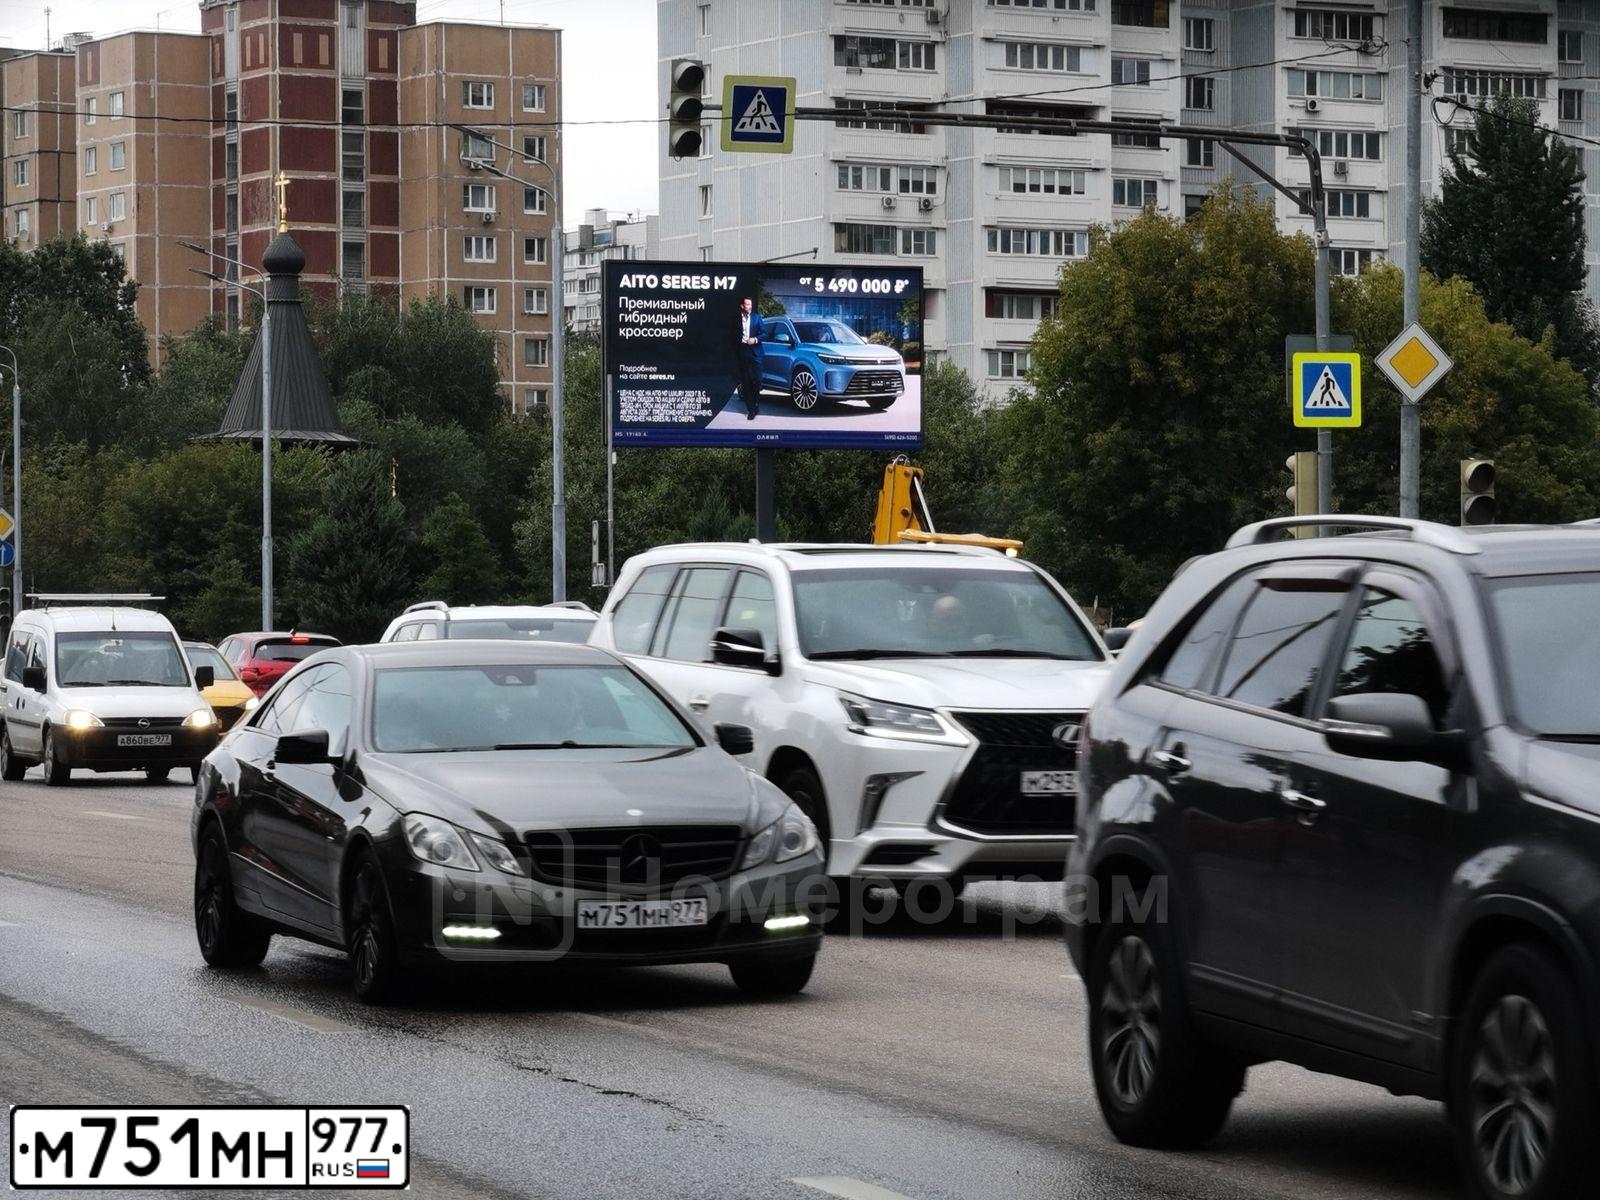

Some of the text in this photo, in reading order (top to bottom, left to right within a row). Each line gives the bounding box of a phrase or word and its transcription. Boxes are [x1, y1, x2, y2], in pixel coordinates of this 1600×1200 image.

[619, 274, 737, 290] AITO SERES M7
[814, 277, 825, 292] 5
[828, 278, 858, 293] 490
[861, 279, 891, 293] 000
[619, 296, 705, 311] Премиальный
[619, 311, 687, 325] гибридный
[619, 327, 684, 340] кроссовер
[619, 364, 657, 373] Подробнее
[582, 900, 703, 927] М751МН 977
